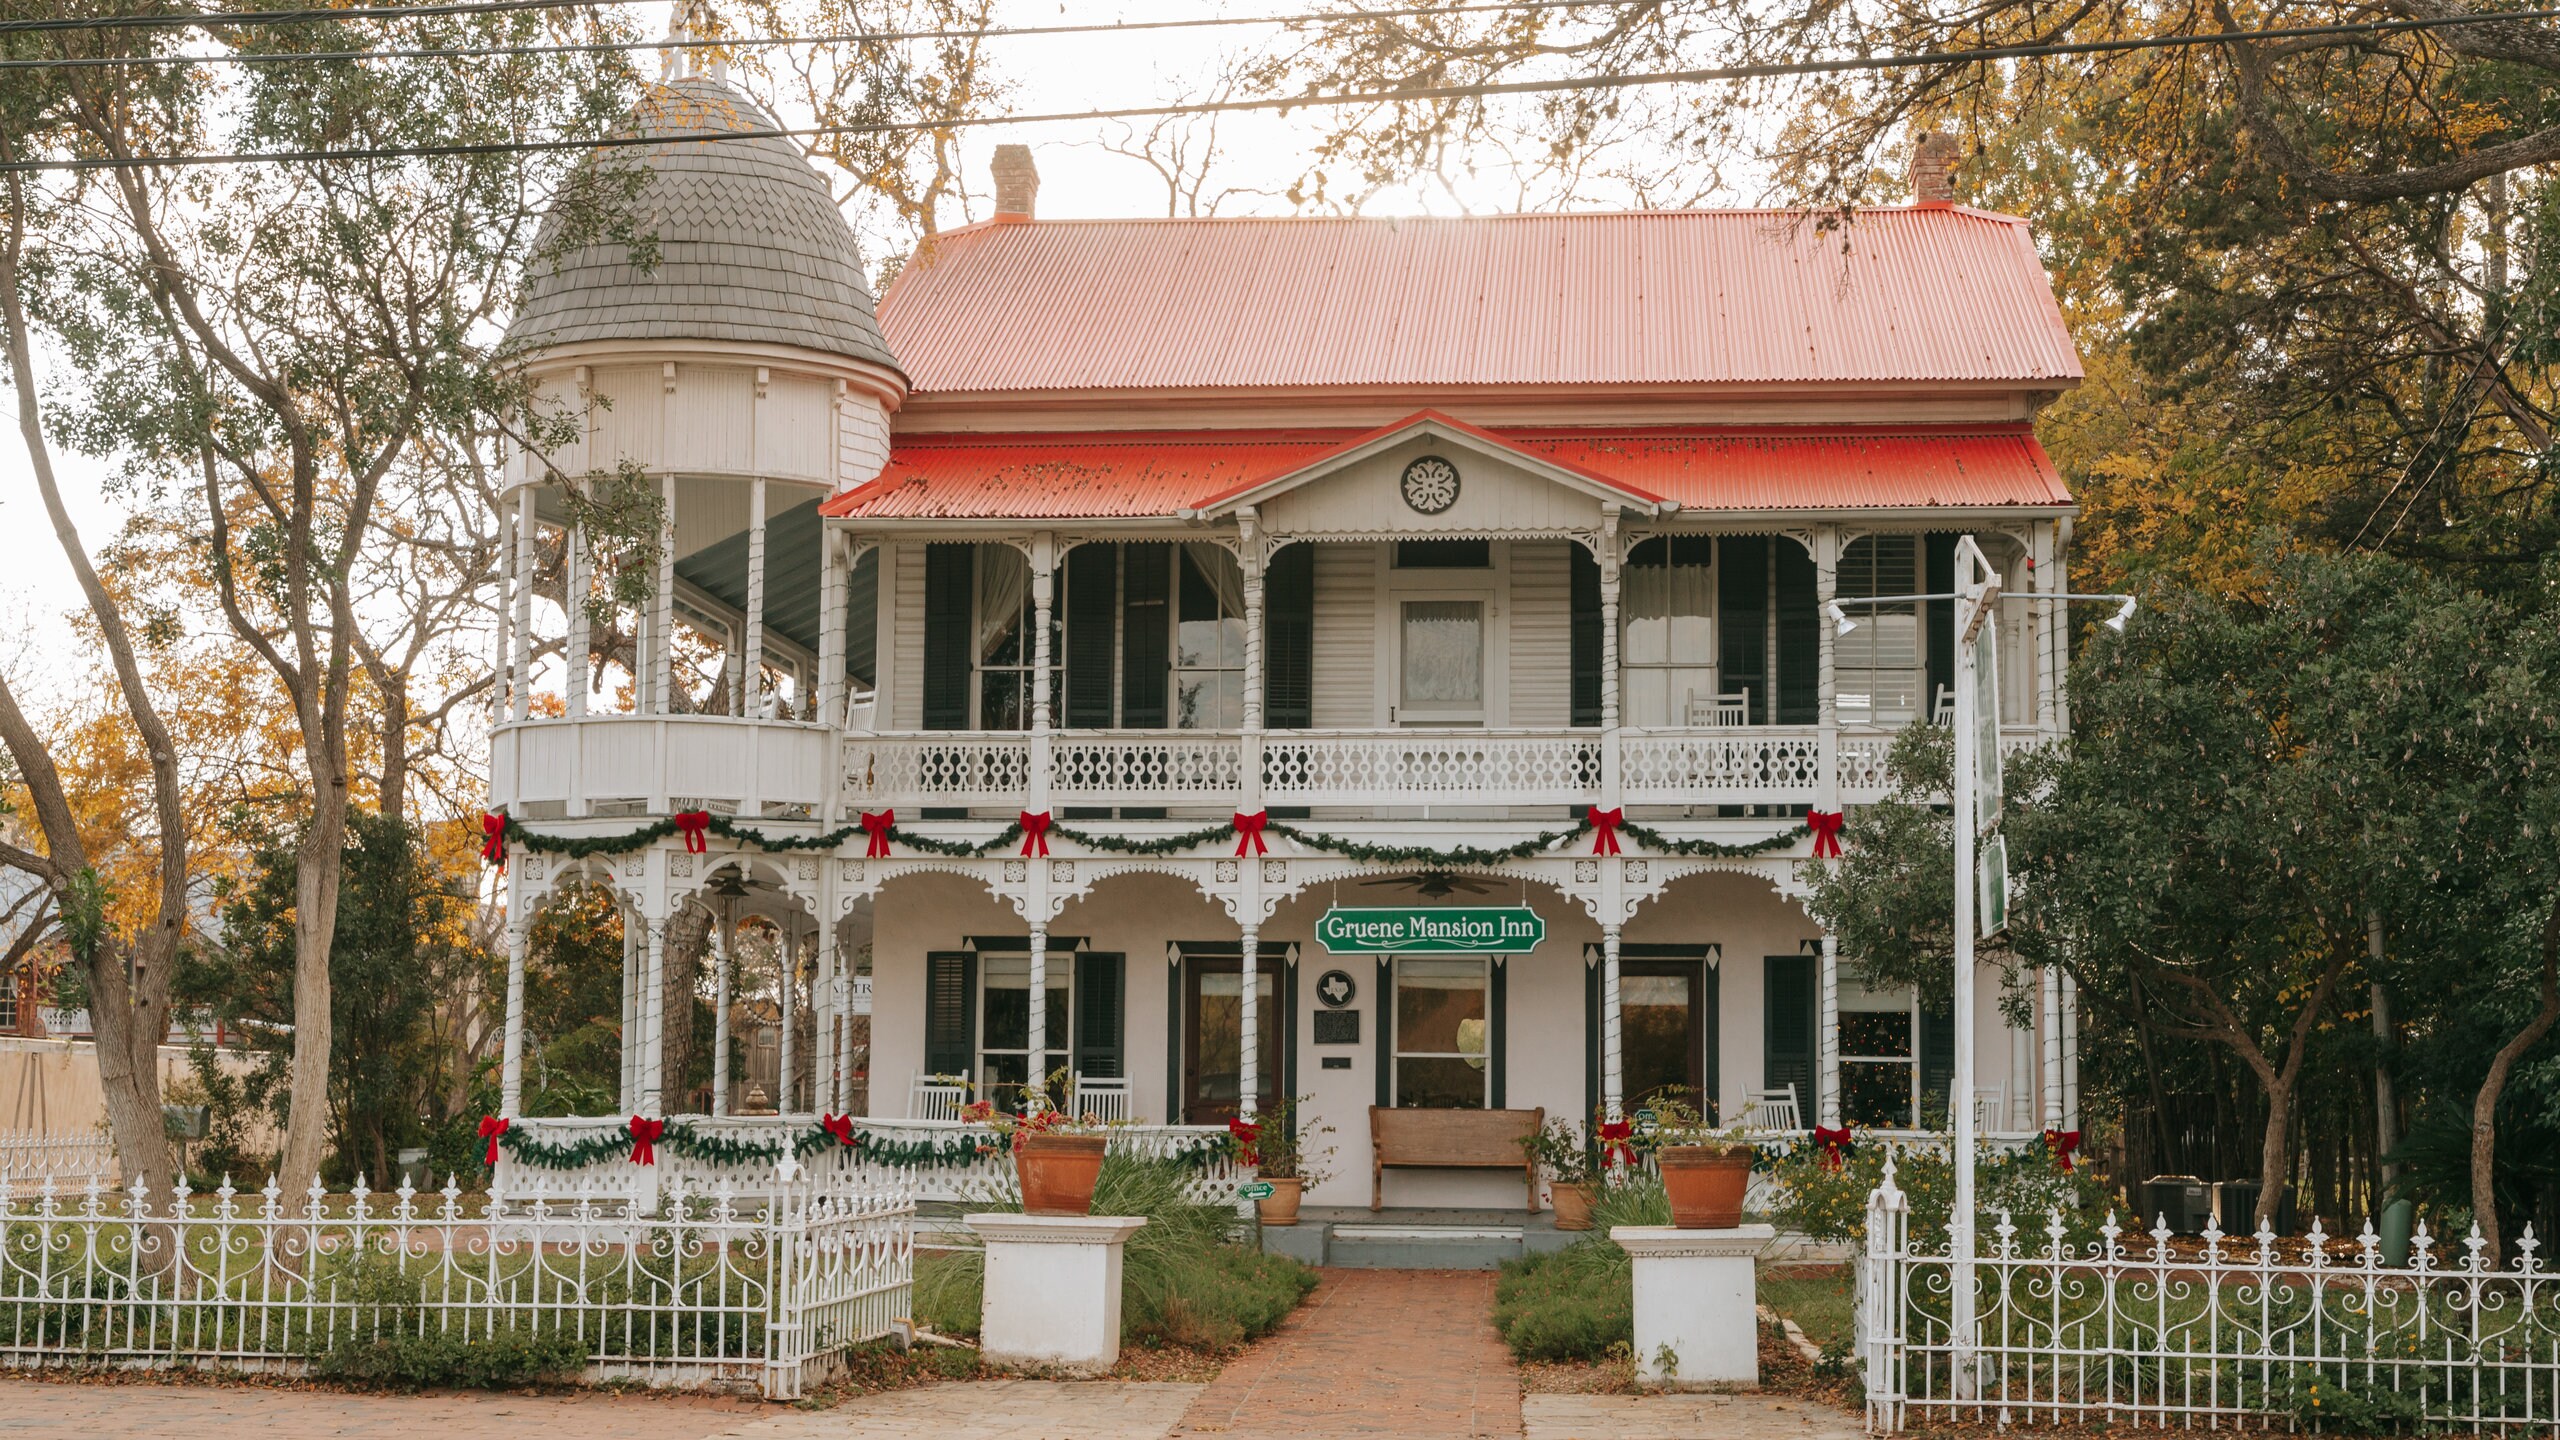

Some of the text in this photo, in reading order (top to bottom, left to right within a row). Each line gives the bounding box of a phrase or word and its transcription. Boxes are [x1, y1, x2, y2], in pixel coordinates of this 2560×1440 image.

[1327, 916, 1535, 938] Gruene Mansion Inn
[1244, 1184, 1268, 1192] Office
